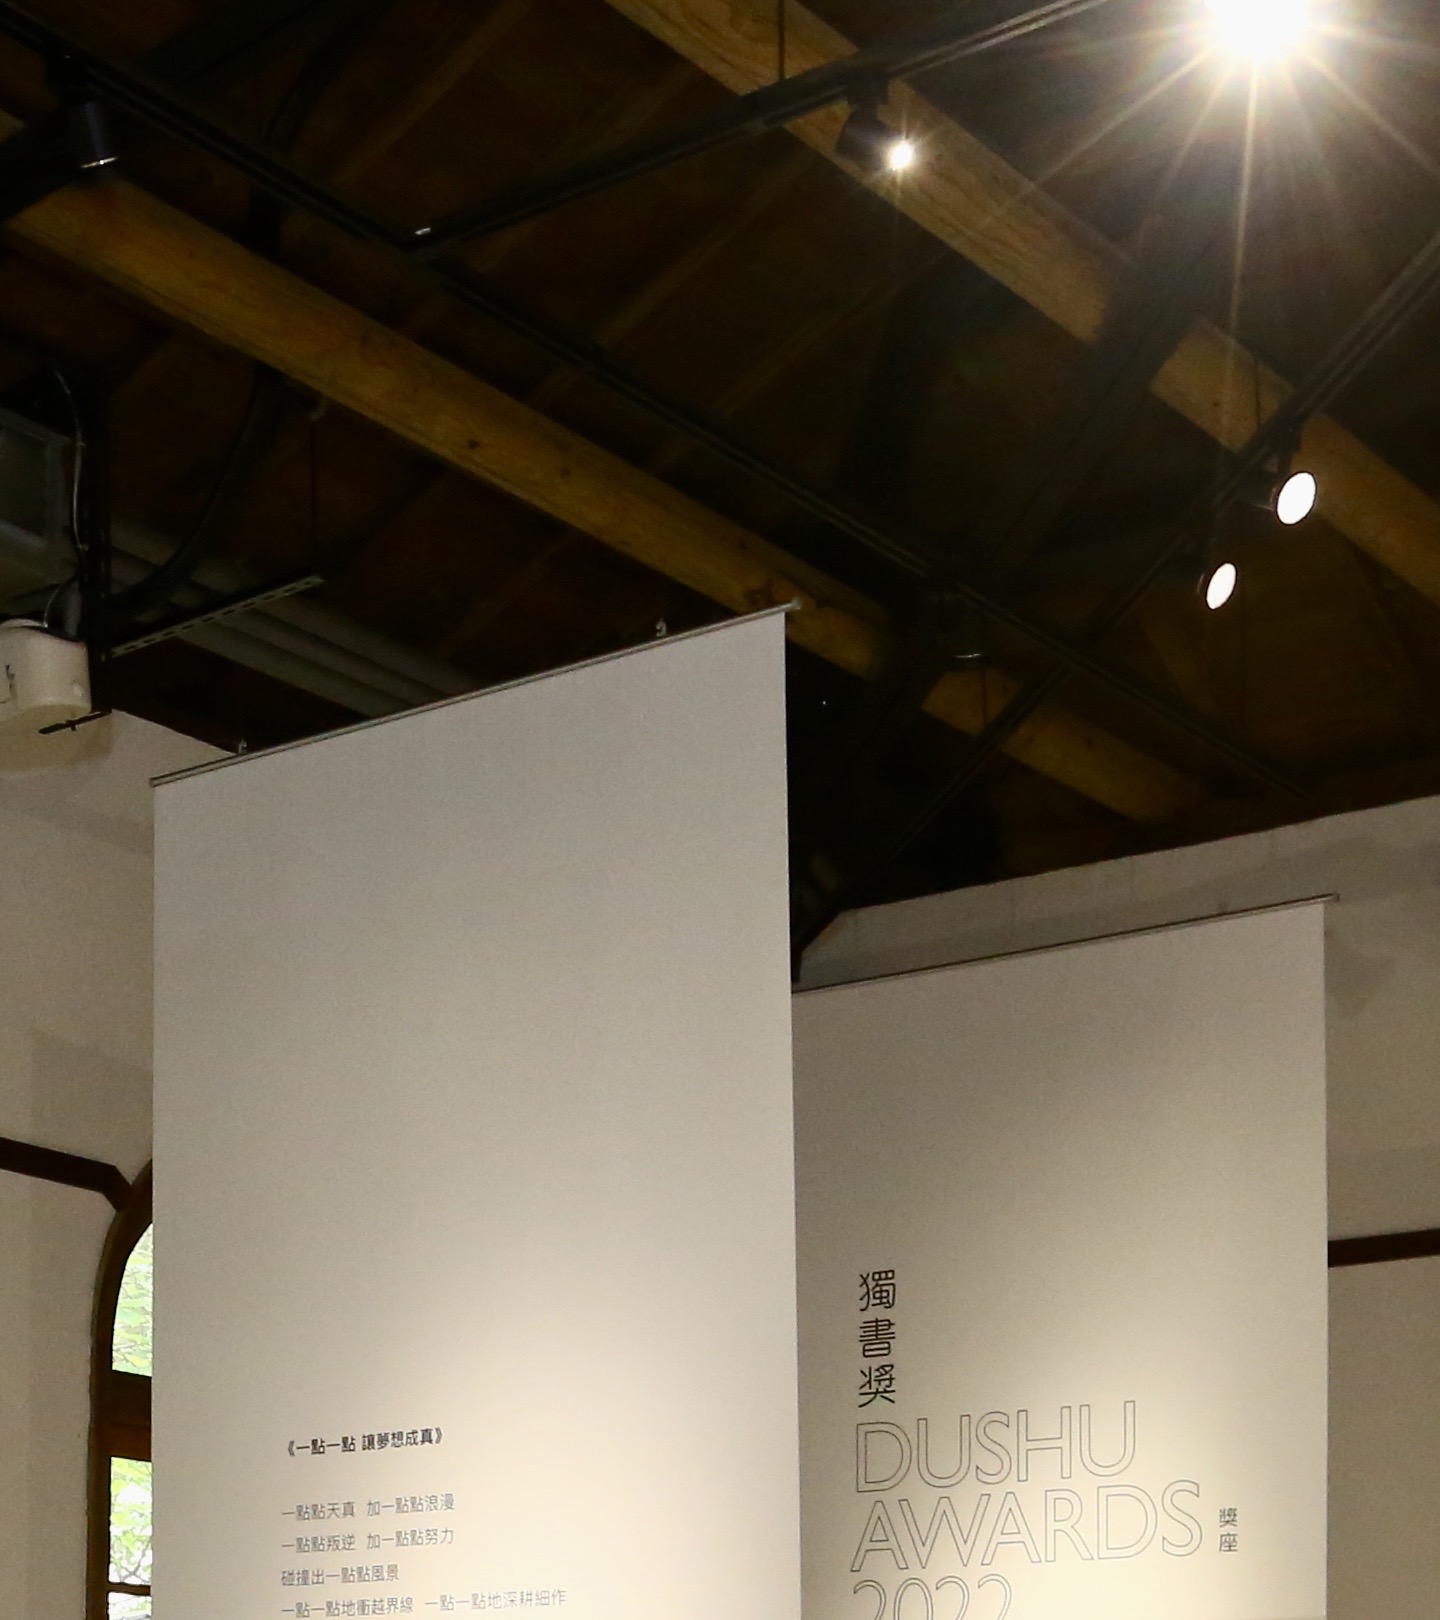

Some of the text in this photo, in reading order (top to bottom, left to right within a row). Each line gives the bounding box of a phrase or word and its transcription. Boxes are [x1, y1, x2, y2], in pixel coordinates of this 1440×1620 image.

[858, 1269, 896, 1408] 獨書獎
[856, 1400, 1136, 1492] DUSHU
[850, 1480, 1203, 1572] AWARDS
